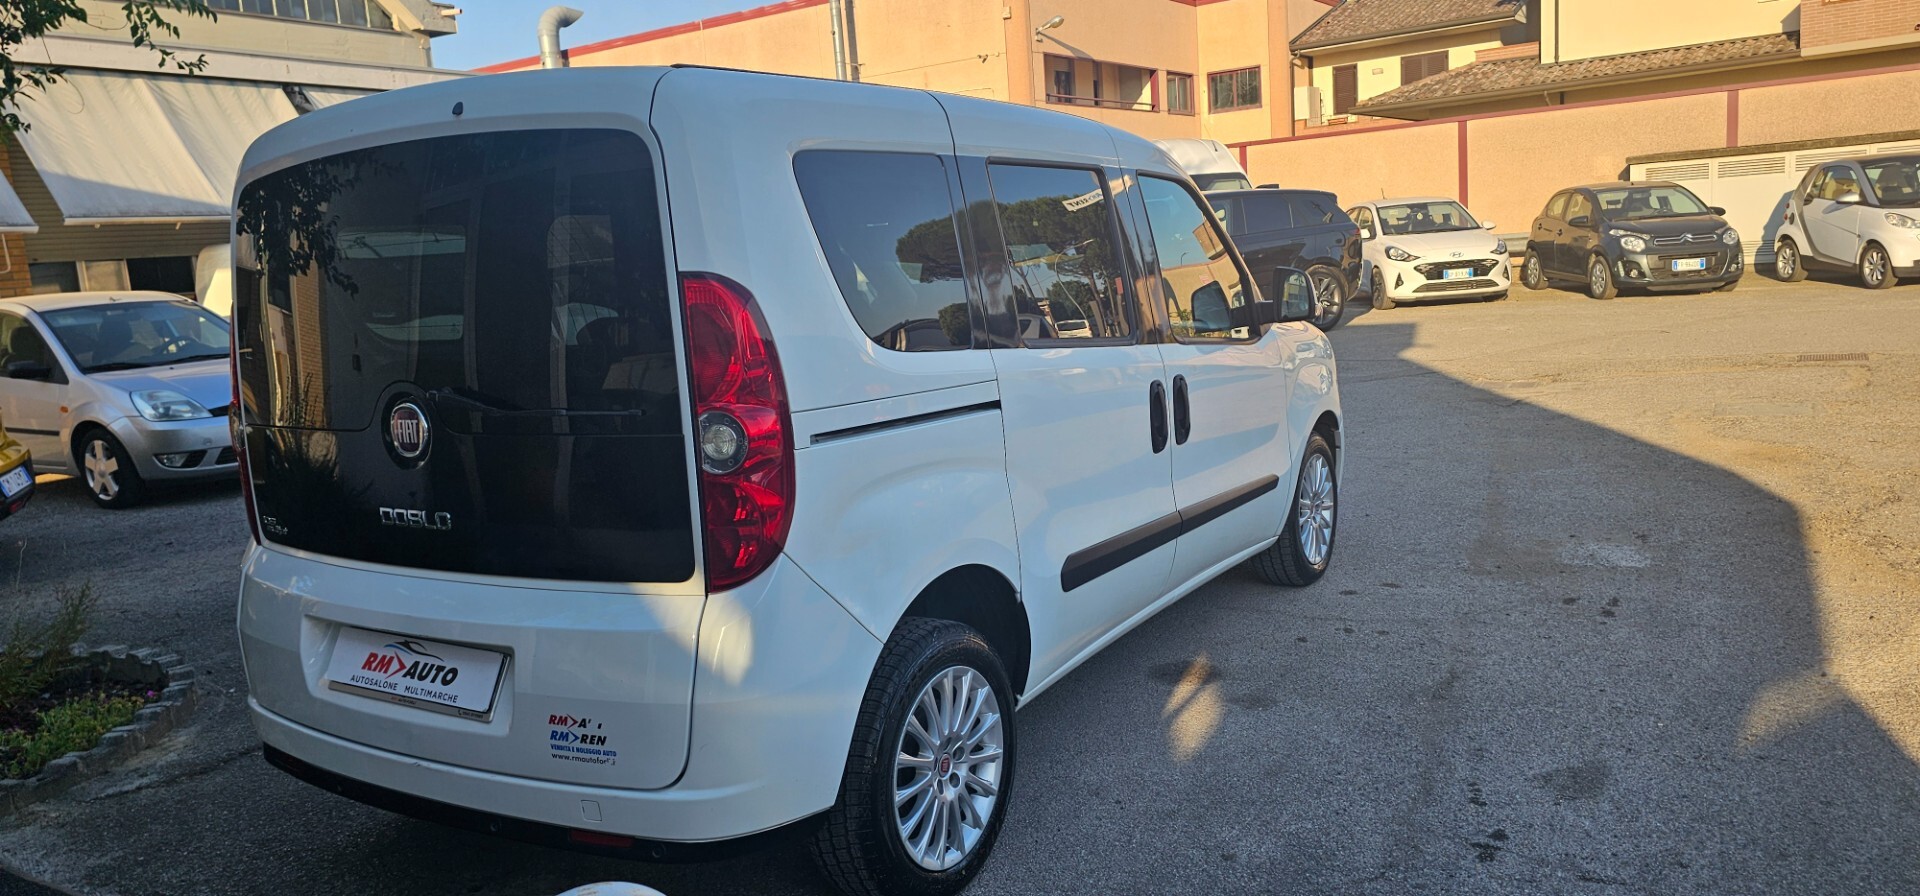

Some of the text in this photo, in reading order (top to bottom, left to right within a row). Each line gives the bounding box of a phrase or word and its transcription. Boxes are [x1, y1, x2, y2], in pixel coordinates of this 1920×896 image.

[398, 419, 418, 443] FIAT
[350, 674, 399, 691] AUTOSALONE
[404, 685, 459, 703] MULTIMARCHE
[550, 744, 571, 752] VENDITA
[576, 747, 601, 755] NOLEGGIO
[603, 749, 617, 757] AUTO
